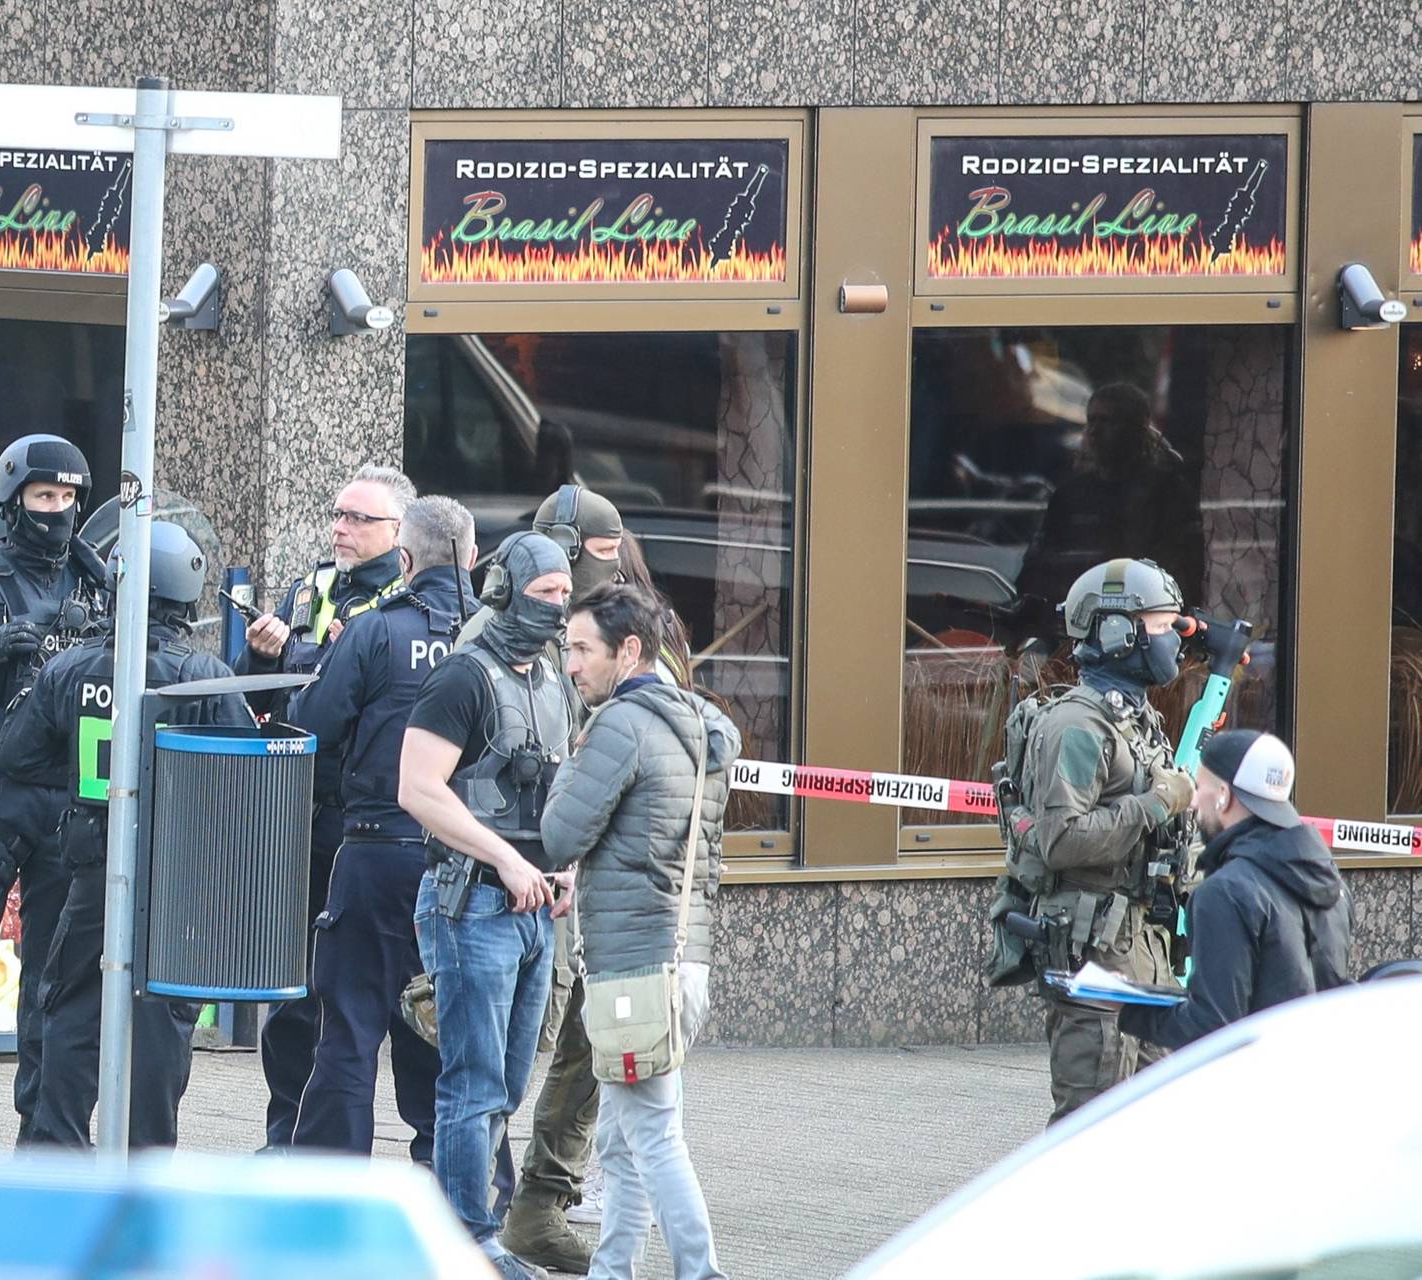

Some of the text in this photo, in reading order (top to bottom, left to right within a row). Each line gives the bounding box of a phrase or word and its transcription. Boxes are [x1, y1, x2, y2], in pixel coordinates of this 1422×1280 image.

[456, 156, 749, 179] RODIZIO-SPEZIALITÄT
[962, 151, 1249, 175] RODIZIO-SPEZIALITÄT
[451, 191, 604, 243] Brasil
[957, 186, 1106, 237] Brasil
